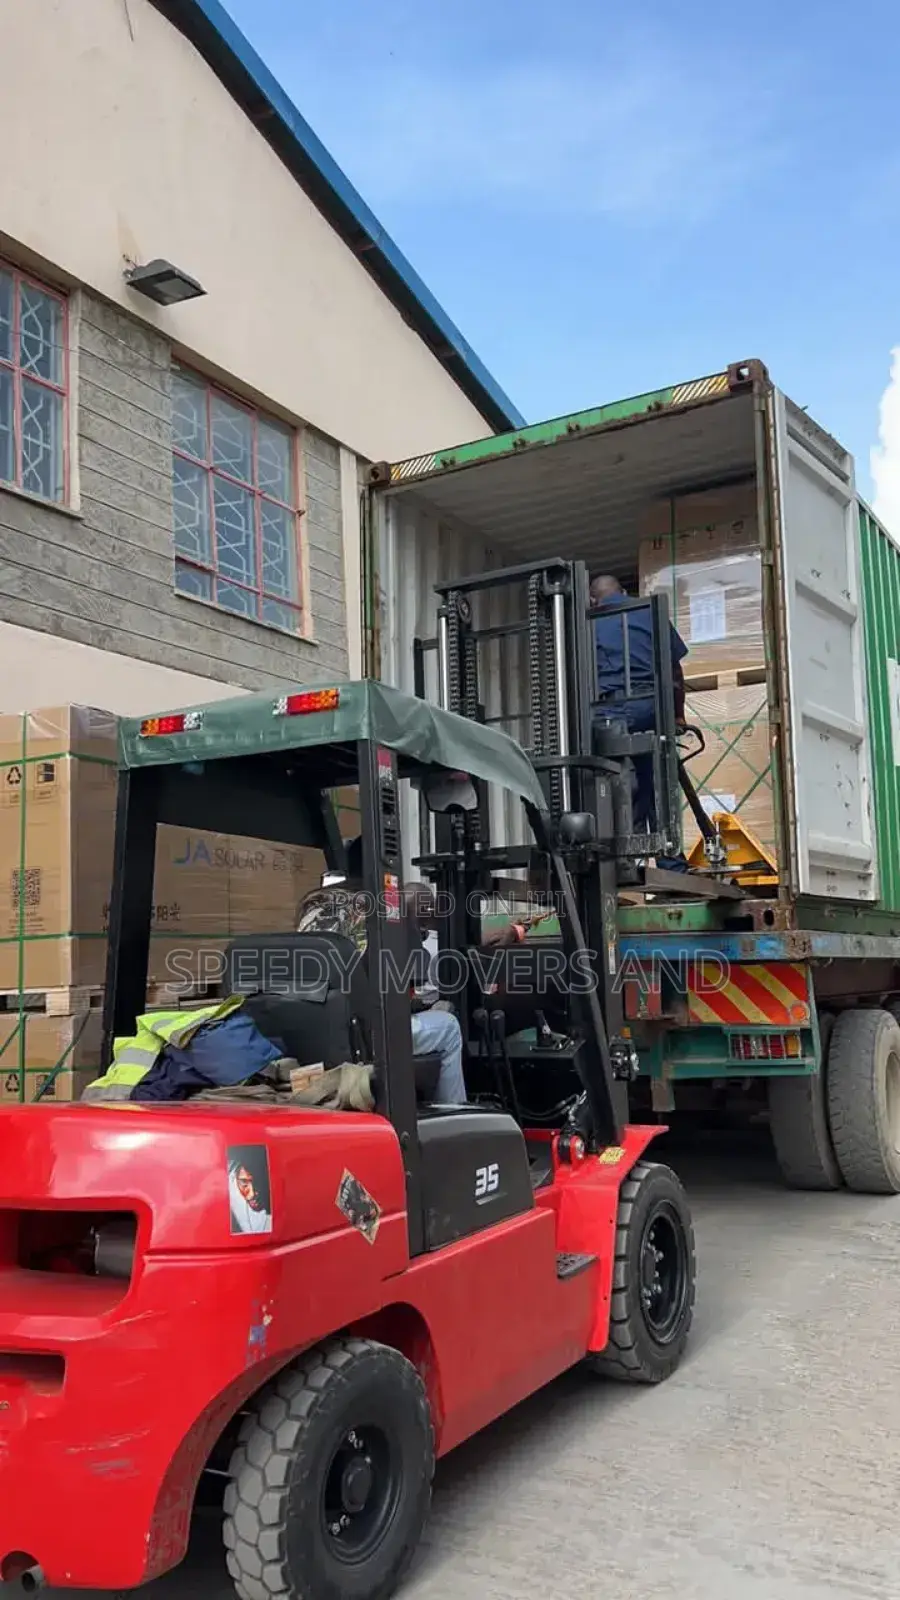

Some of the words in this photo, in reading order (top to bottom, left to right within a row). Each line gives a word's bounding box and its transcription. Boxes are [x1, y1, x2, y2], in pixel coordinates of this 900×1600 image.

[173, 836, 213, 868] JA
[213, 847, 266, 872] SOLAR
[475, 1163, 499, 1196] 35
